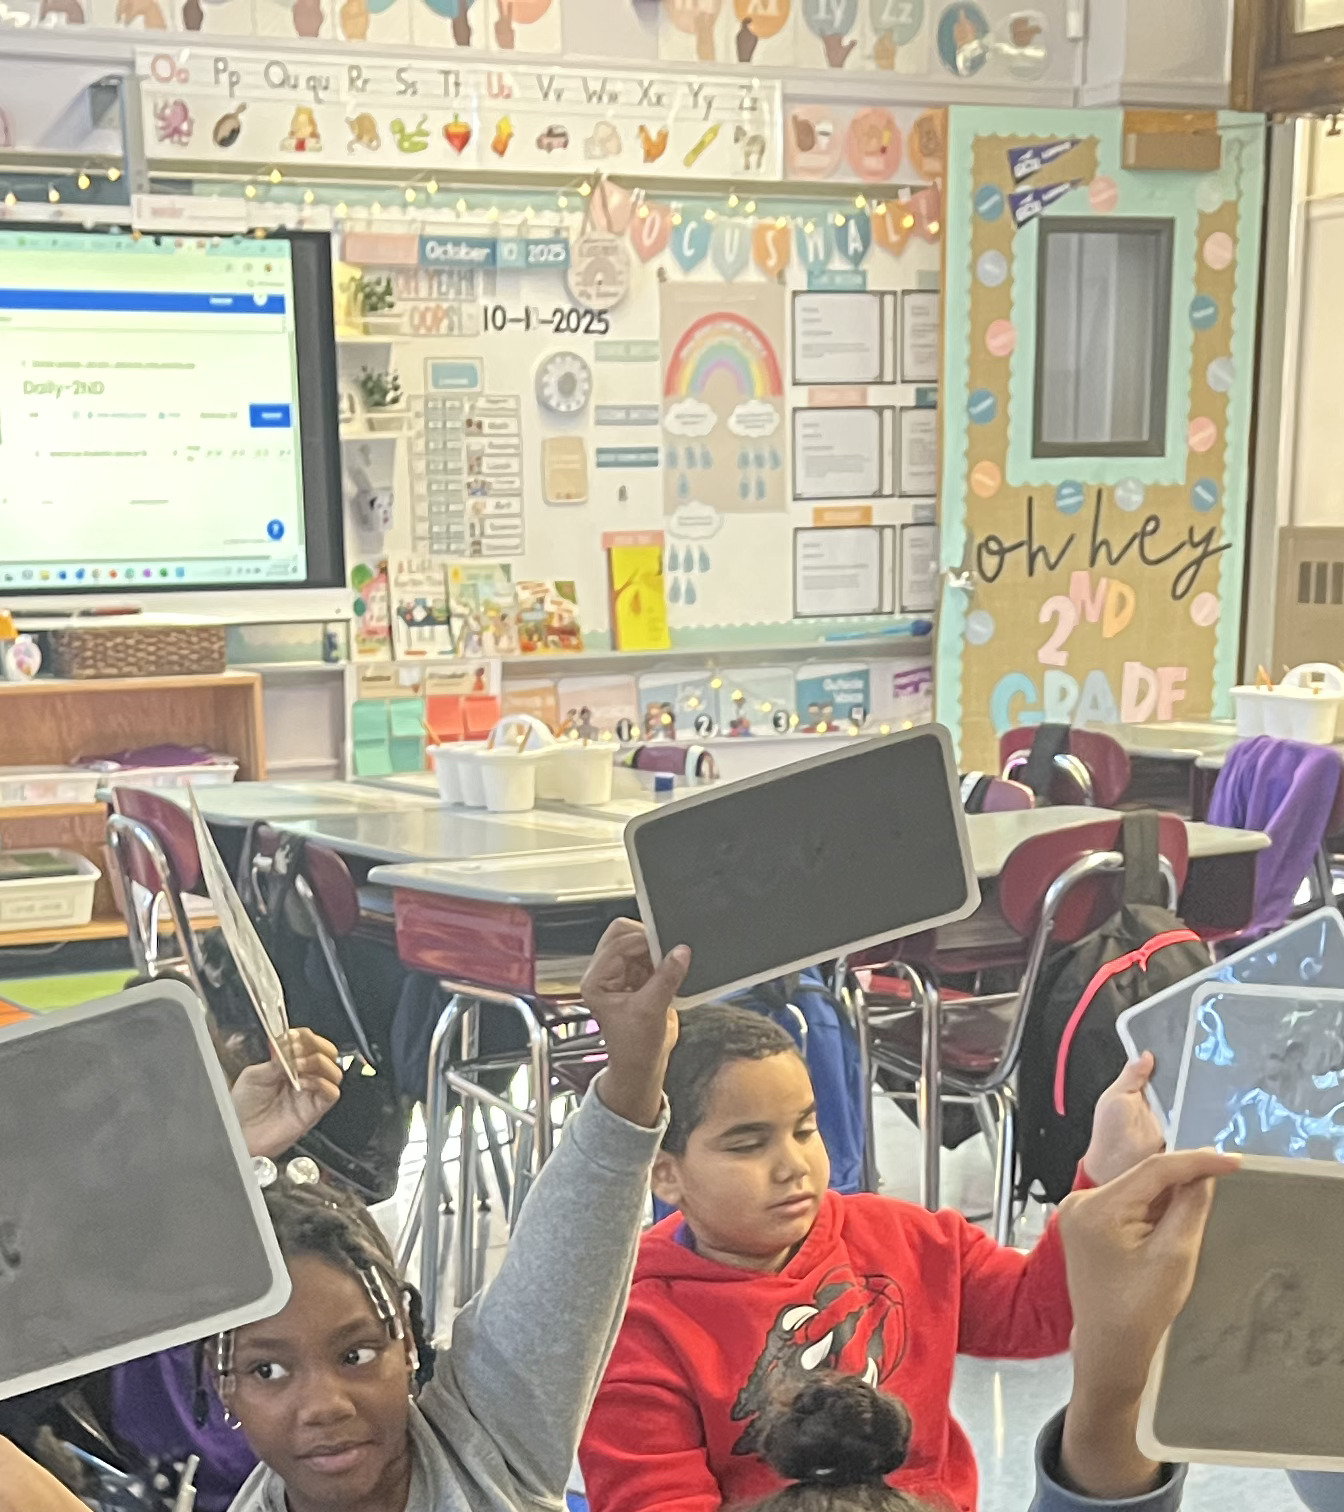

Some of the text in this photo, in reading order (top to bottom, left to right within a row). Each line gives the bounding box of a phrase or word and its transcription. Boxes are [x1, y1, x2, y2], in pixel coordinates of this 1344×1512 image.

[213, 58, 241, 96] Pp
[396, 67, 418, 97] Ss
[536, 75, 564, 102] Vv
[637, 80, 665, 107] Xx
[686, 83, 713, 120] Yy
[425, 240, 490, 261] October
[977, 488, 1232, 600] oh hey
[1038, 570, 1136, 666] 2ND
[697, 716, 711, 735] 2
[775, 711, 788, 732] 3
